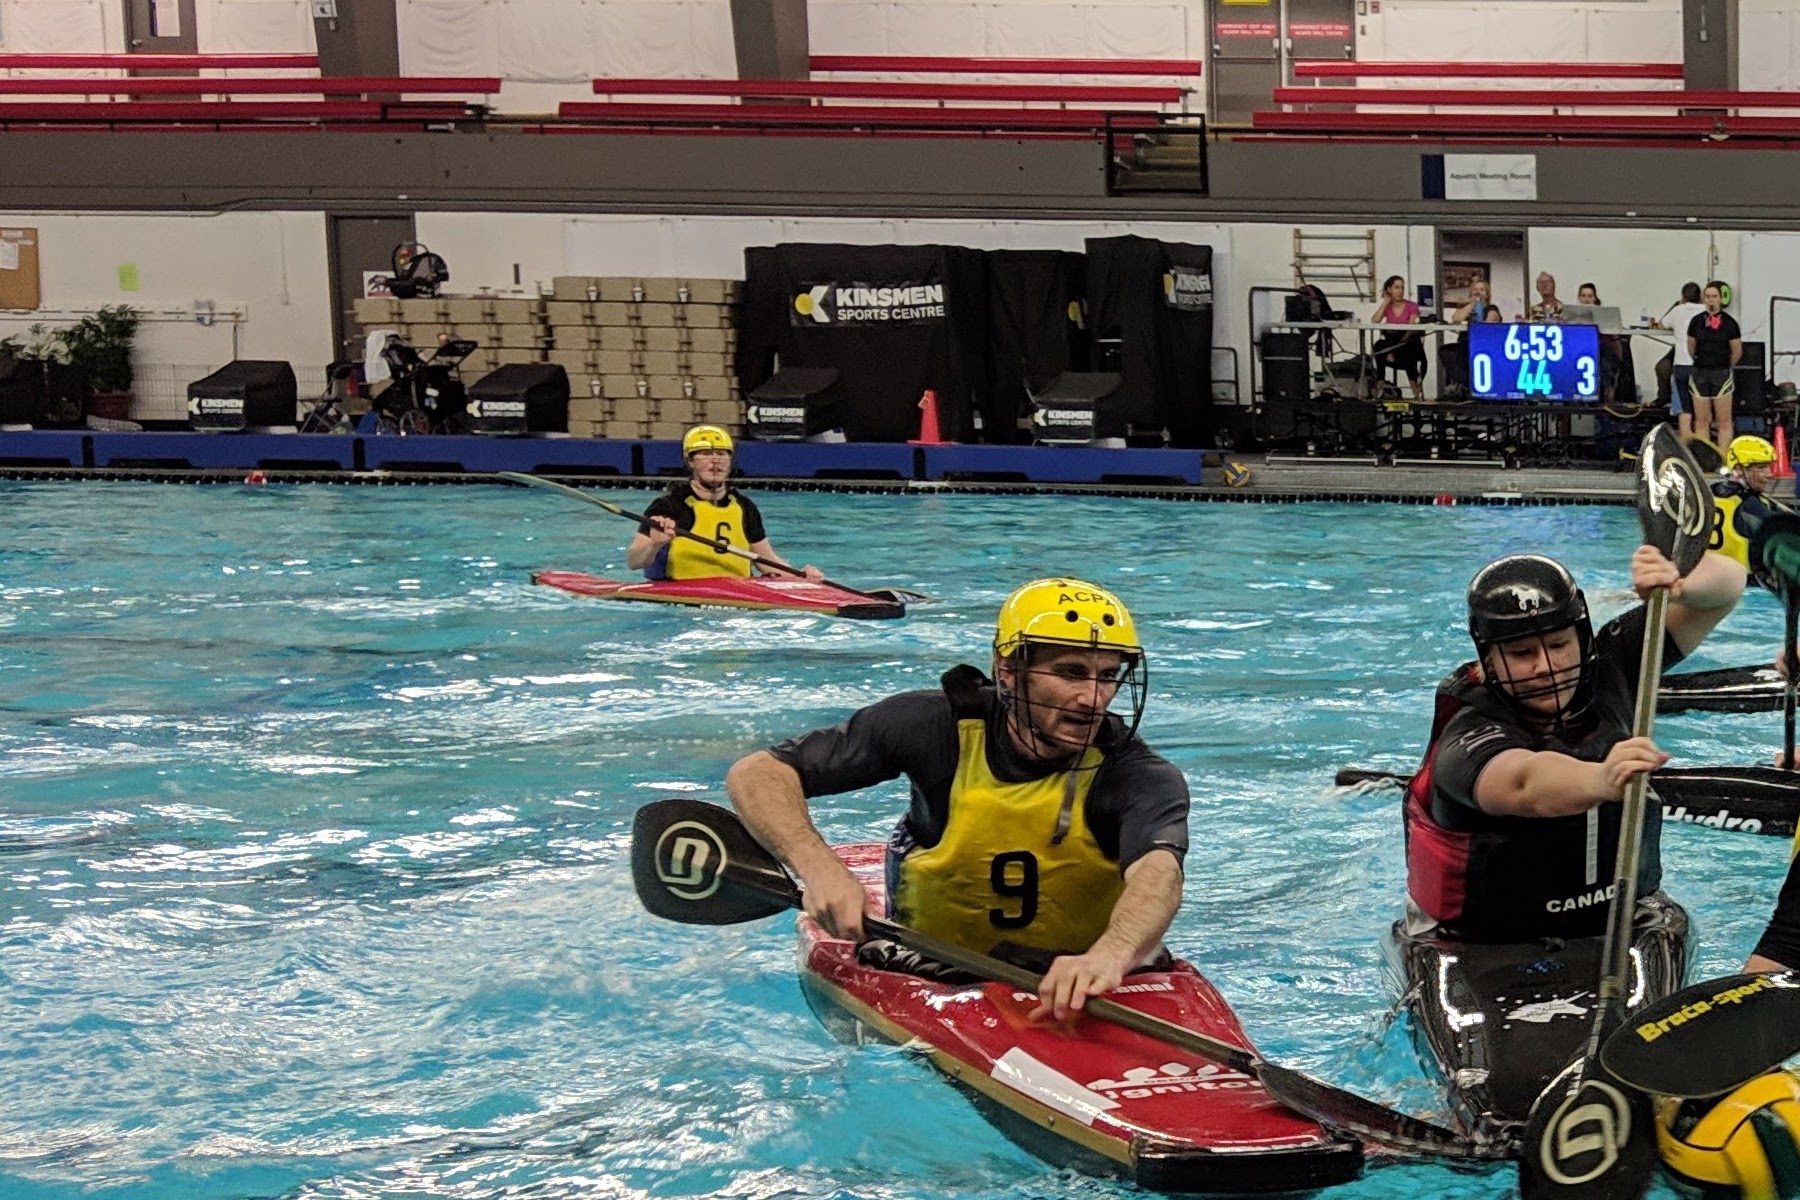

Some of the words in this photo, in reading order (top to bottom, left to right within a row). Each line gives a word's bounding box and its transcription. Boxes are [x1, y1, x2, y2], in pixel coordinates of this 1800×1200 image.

[835, 284, 944, 307] KINSMEN
[837, 308, 889, 321] SPORTS
[891, 305, 945, 320] CENTRE
[1504, 324, 1563, 361] 6:53
[1473, 353, 1492, 393] 0
[1516, 359, 1552, 395] 44
[1576, 356, 1595, 395] 3
[713, 521, 731, 554] 6
[989, 850, 1039, 930] 9
[1545, 883, 1618, 913] CANAD
